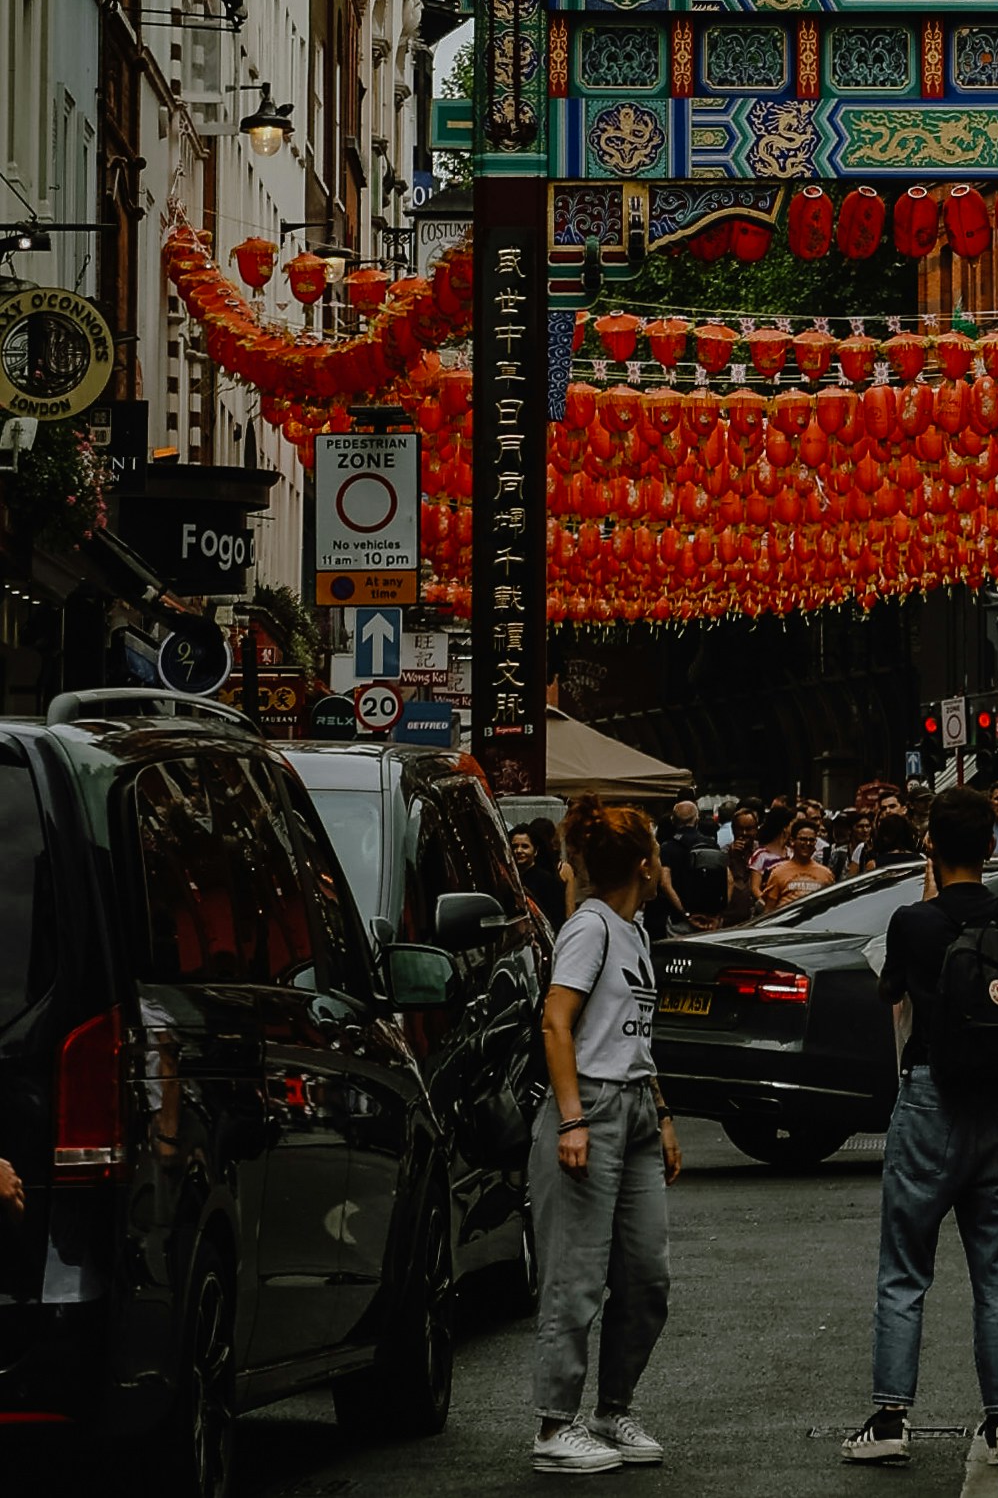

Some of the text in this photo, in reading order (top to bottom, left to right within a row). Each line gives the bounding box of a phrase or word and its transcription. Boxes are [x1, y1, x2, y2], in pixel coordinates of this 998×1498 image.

[421, 223, 474, 245] COSTUM
[10, 395, 71, 415] LONDON
[326, 439, 407, 450] PEDESTRIAN
[337, 453, 395, 469] ZONE
[181, 523, 246, 571] Fogo
[333, 540, 400, 550] No vehicles
[322, 555, 332, 565] 11
[335, 557, 352, 565] am
[364, 552, 382, 565] 10
[386, 555, 409, 567] pm
[365, 576, 403, 590] At any
[371, 589, 397, 599] time
[414, 634, 436, 669] 旺記
[402, 671, 447, 685] Wong Kei
[362, 696, 397, 717] 20
[316, 716, 354, 726] RELX
